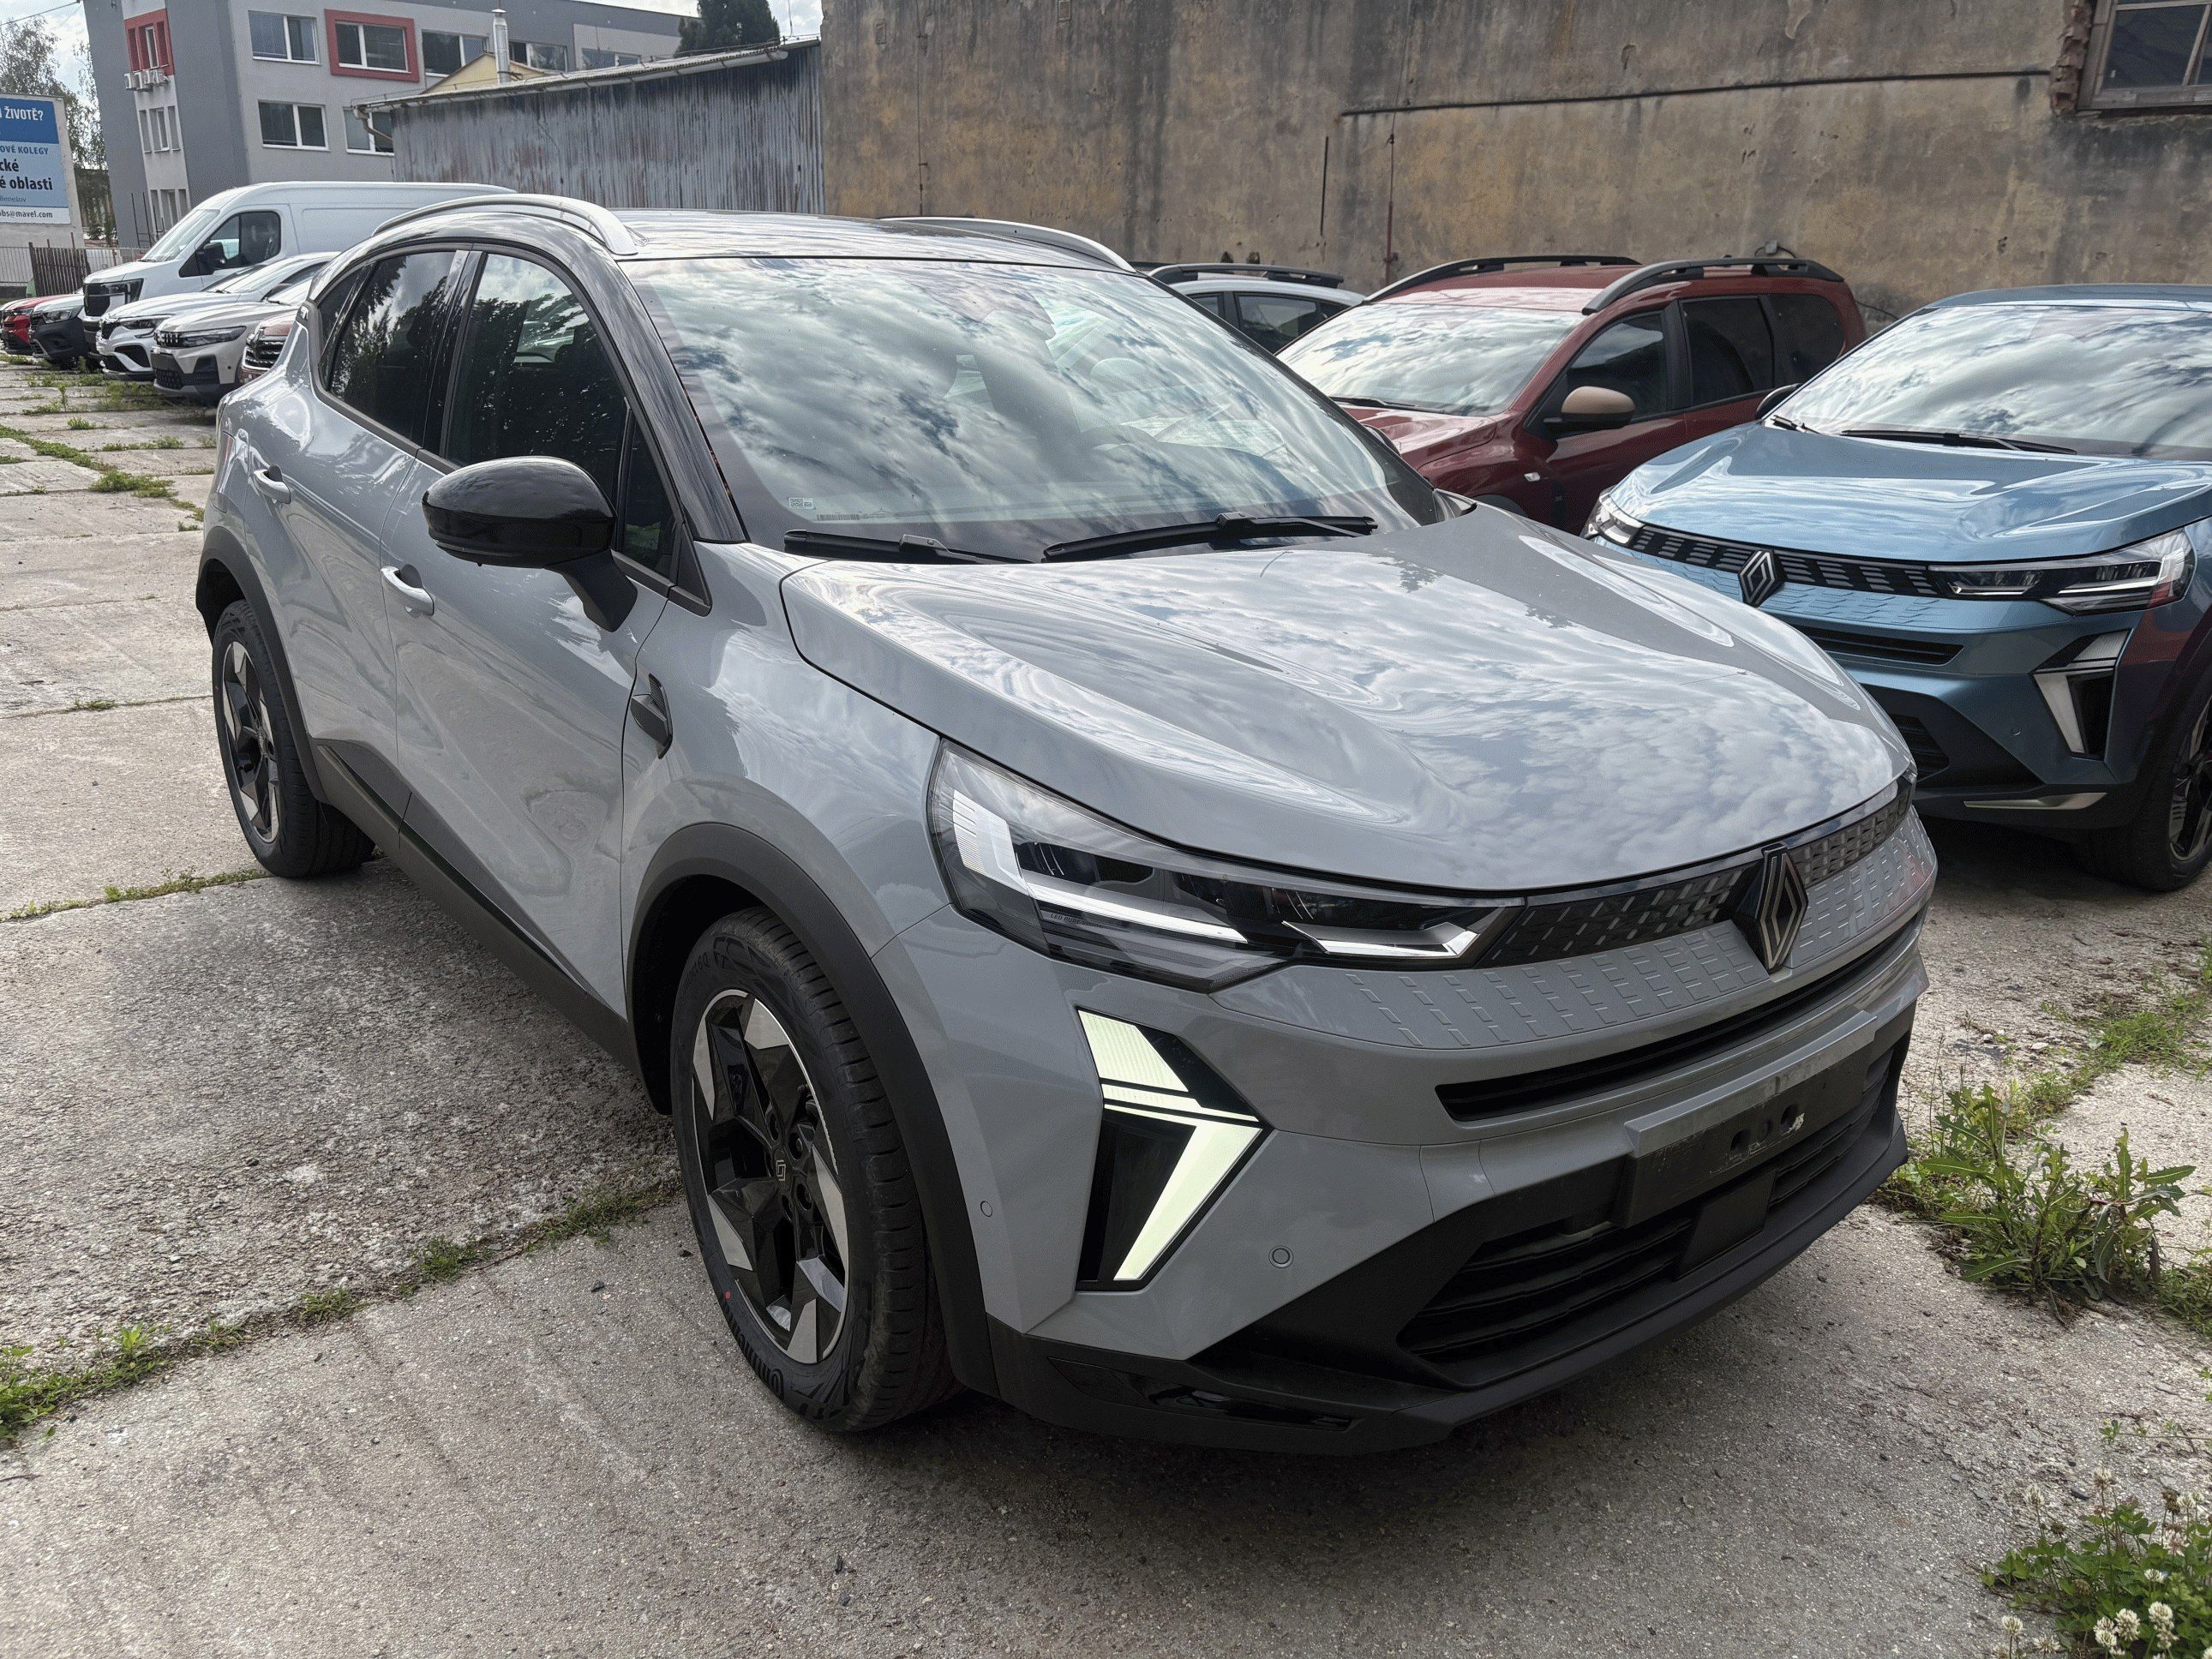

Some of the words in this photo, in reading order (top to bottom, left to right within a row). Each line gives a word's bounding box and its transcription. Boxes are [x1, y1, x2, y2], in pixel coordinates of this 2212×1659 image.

[4, 106, 44, 121] ŽIVOTĚ?
[18, 147, 49, 155] KOLEGY
[9, 177, 53, 190] oblasti
[0, 210, 53, 219] bs@mavel.com
